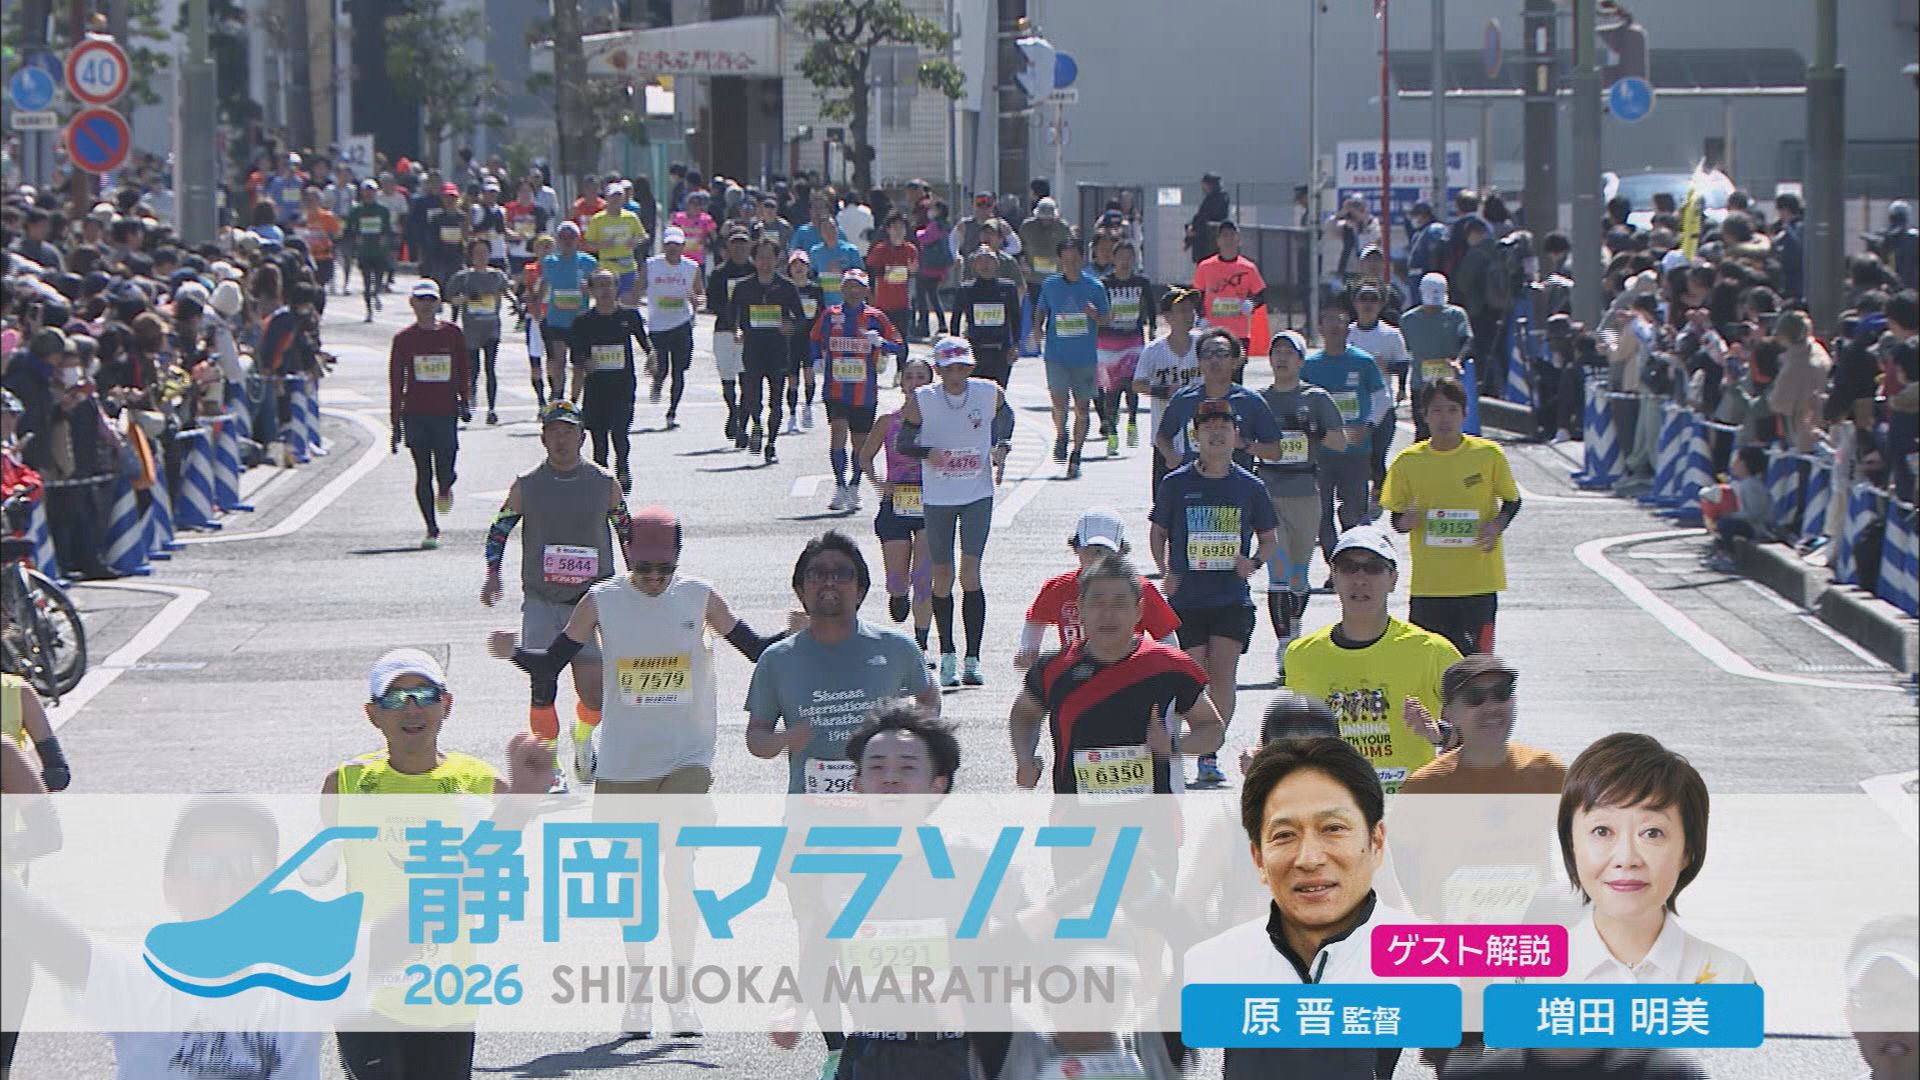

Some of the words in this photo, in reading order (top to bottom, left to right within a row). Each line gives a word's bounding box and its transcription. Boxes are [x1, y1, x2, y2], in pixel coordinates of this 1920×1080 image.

[82, 59, 117, 87] 40
[1440, 521, 1473, 534] 9152
[1202, 544, 1235, 557] 6920
[558, 557, 592, 572] 5844
[638, 671, 685, 690] 7579
[812, 687, 865, 703] Shonan
[810, 712, 866, 728] Maratho
[1361, 734, 1392, 746] YOUR
[1095, 763, 1145, 785] 6350
